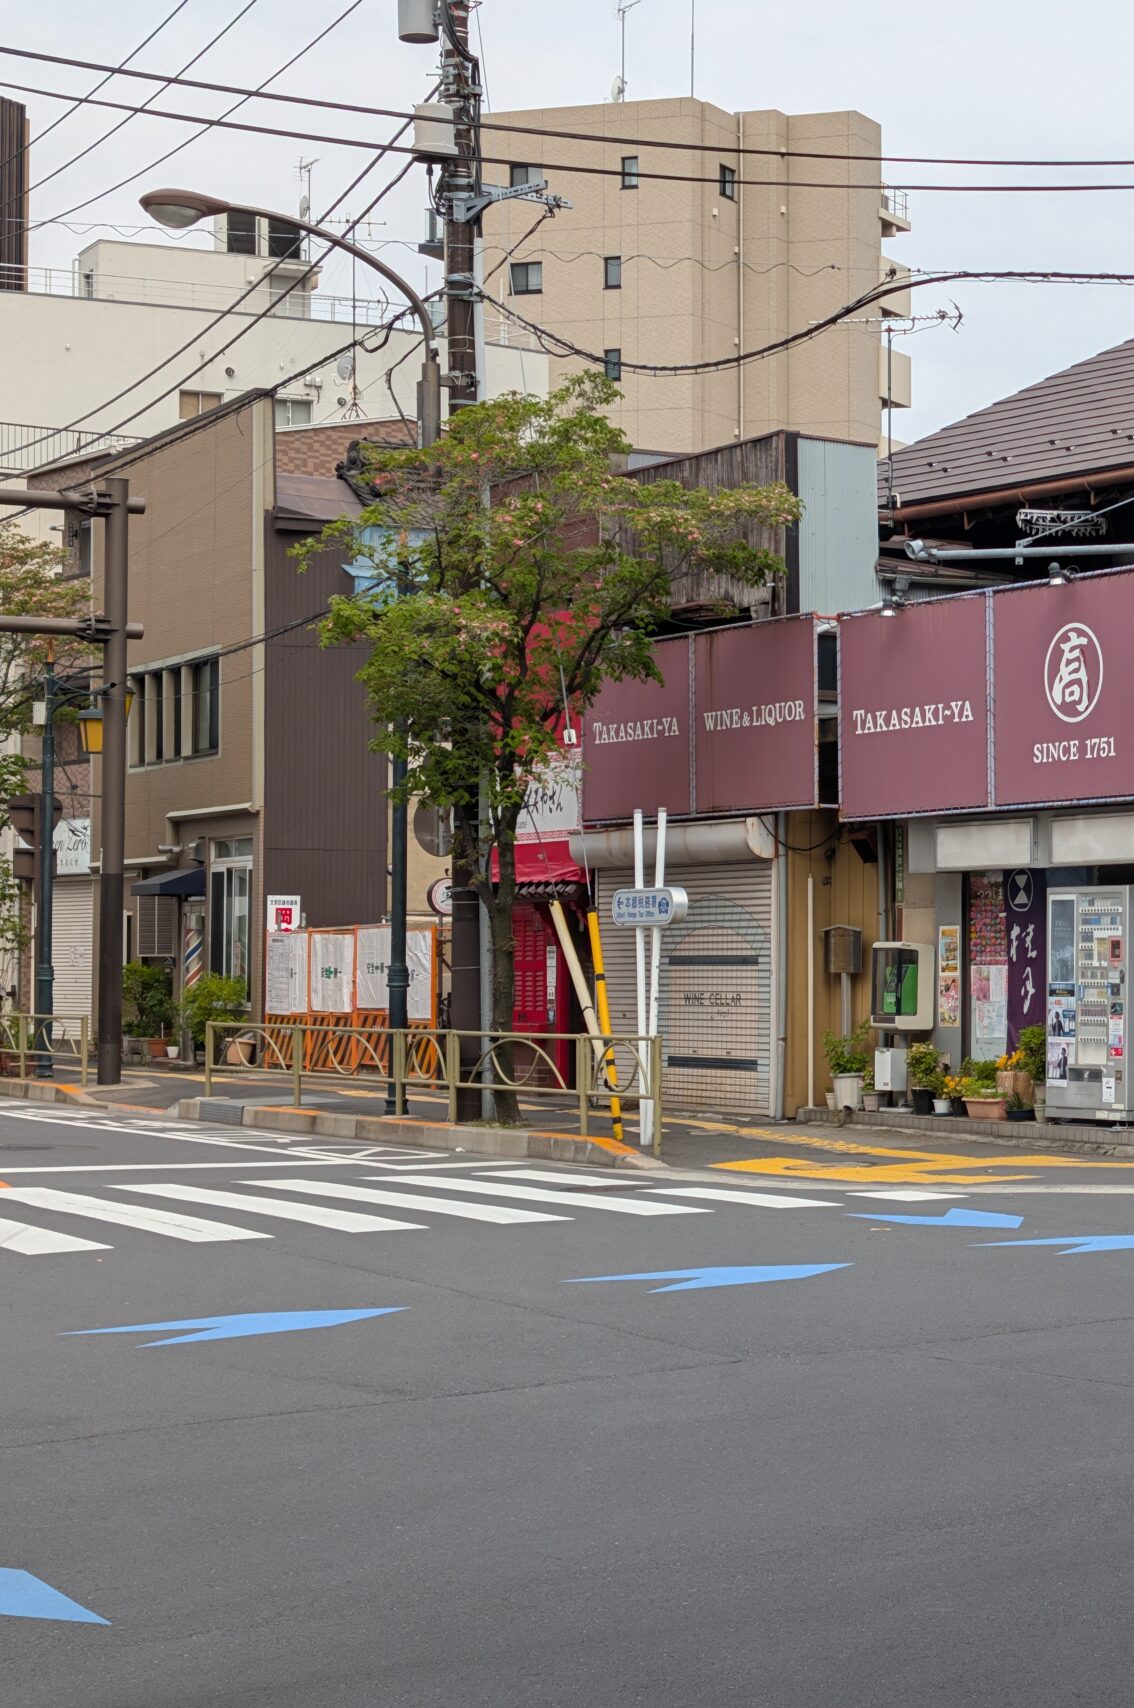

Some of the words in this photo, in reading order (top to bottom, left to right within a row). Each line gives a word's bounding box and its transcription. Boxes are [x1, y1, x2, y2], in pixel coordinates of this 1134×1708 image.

[1033, 740, 1079, 763] SINCE
[1085, 736, 1116, 760] 1751
[683, 992, 705, 1006] WINE
[708, 993, 742, 1007] CELLAR
